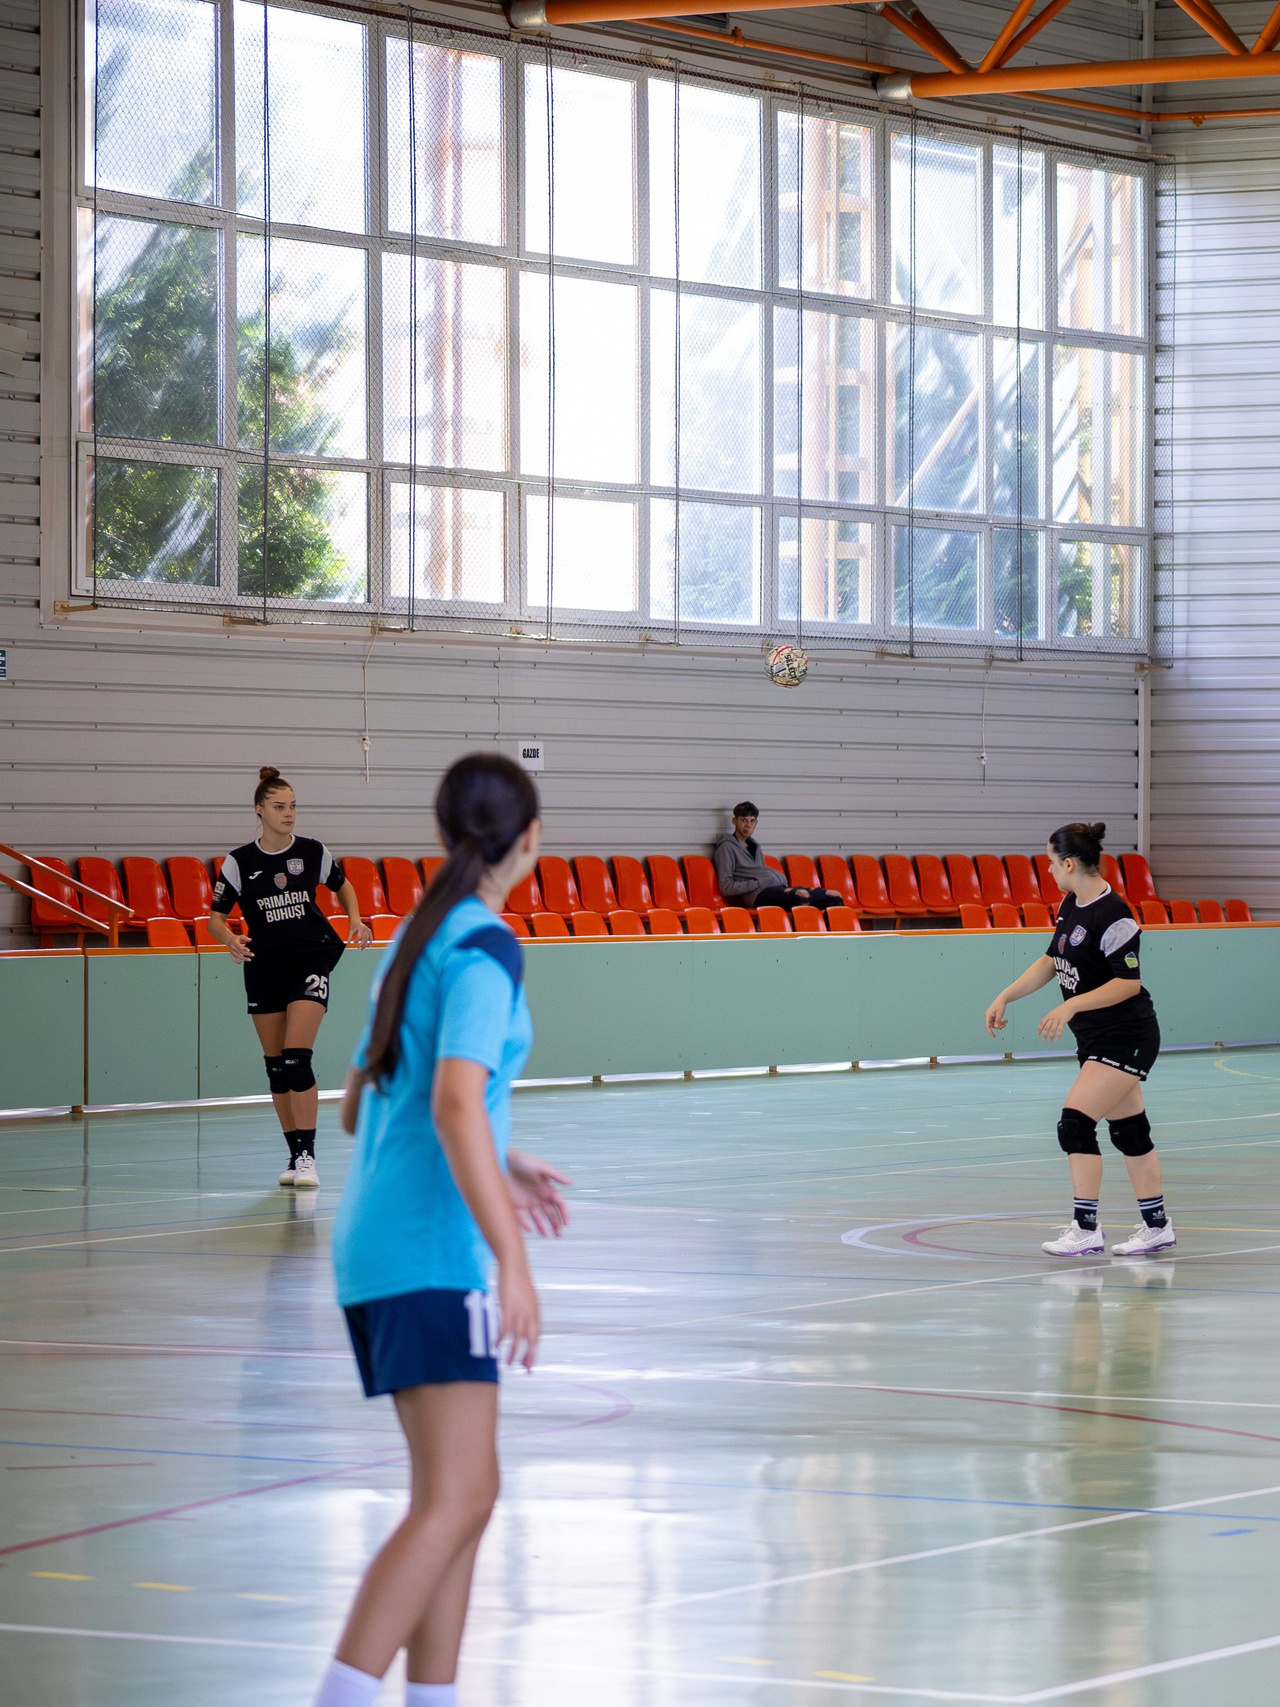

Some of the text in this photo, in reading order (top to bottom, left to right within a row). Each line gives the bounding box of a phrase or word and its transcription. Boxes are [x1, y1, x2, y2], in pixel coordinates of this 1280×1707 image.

[522, 748, 540, 759] GAZDE
[256, 890, 311, 911] PRIMĂRIA
[265, 904, 306, 923] BUHUȘI
[304, 974, 328, 1000] 25
